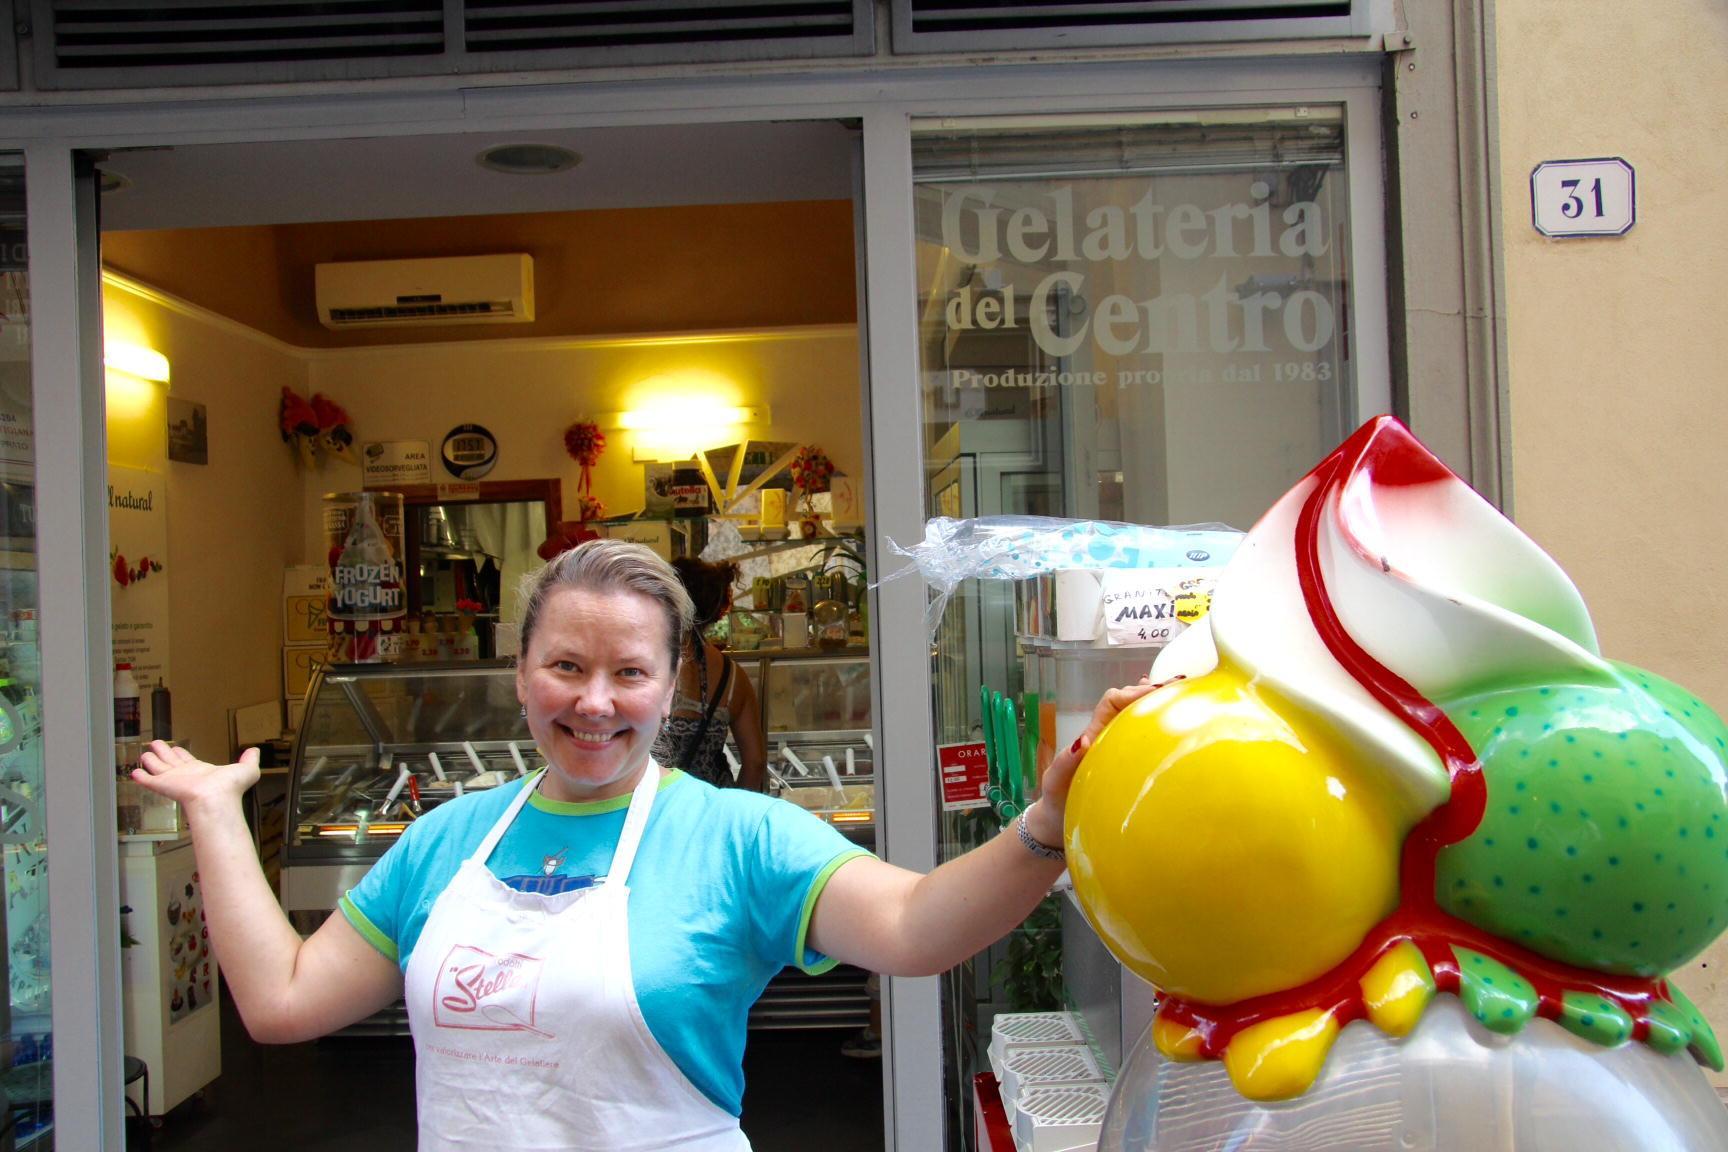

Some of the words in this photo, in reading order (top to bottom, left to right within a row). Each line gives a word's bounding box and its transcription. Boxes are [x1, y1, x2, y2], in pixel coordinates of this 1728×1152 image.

[1560, 177, 1605, 219] 31
[941, 181, 1331, 264] Gelateria
[946, 282, 1019, 330] del
[1029, 269, 1336, 358] Centro
[951, 366, 1108, 389] Produzione
[1223, 362, 1261, 383] dal
[1273, 361, 1332, 383] 1983
[404, 452, 426, 461] AREA
[366, 462, 428, 473] VIDEOSORVEGLIATA
[334, 564, 401, 585] FROZEN
[334, 586, 401, 608] YOGURT
[957, 747, 987, 758] ORAR
[504, 1055, 518, 1066] del
